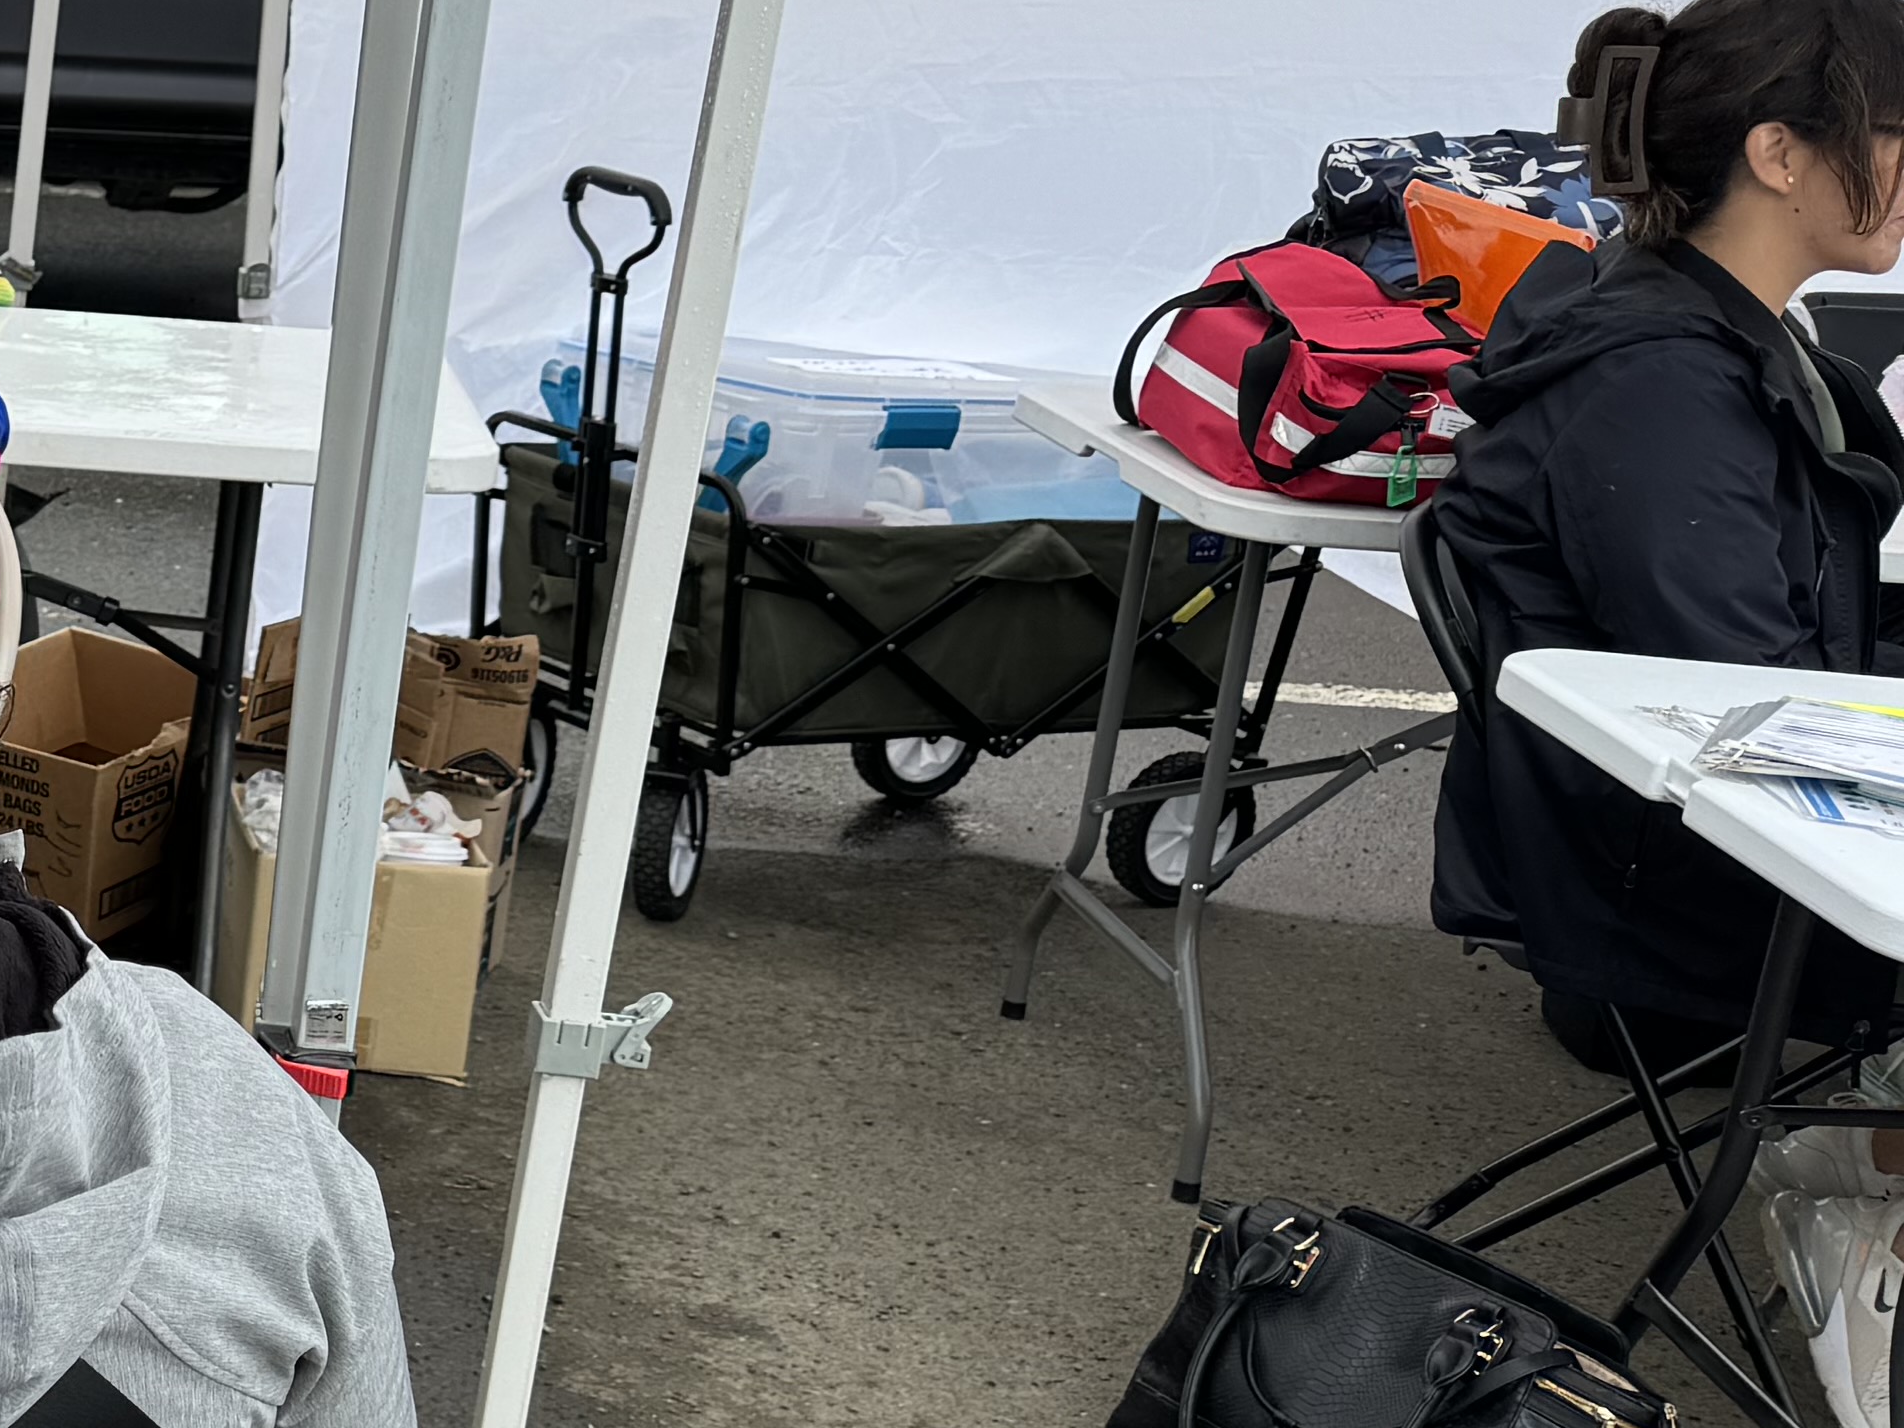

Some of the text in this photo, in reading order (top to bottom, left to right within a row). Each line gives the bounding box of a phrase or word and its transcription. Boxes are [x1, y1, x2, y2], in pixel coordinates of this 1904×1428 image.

[482, 644, 523, 663] P&G
[123, 761, 172, 790] USDA
[3, 792, 42, 817] BAGS
[120, 785, 169, 817] FOOD
